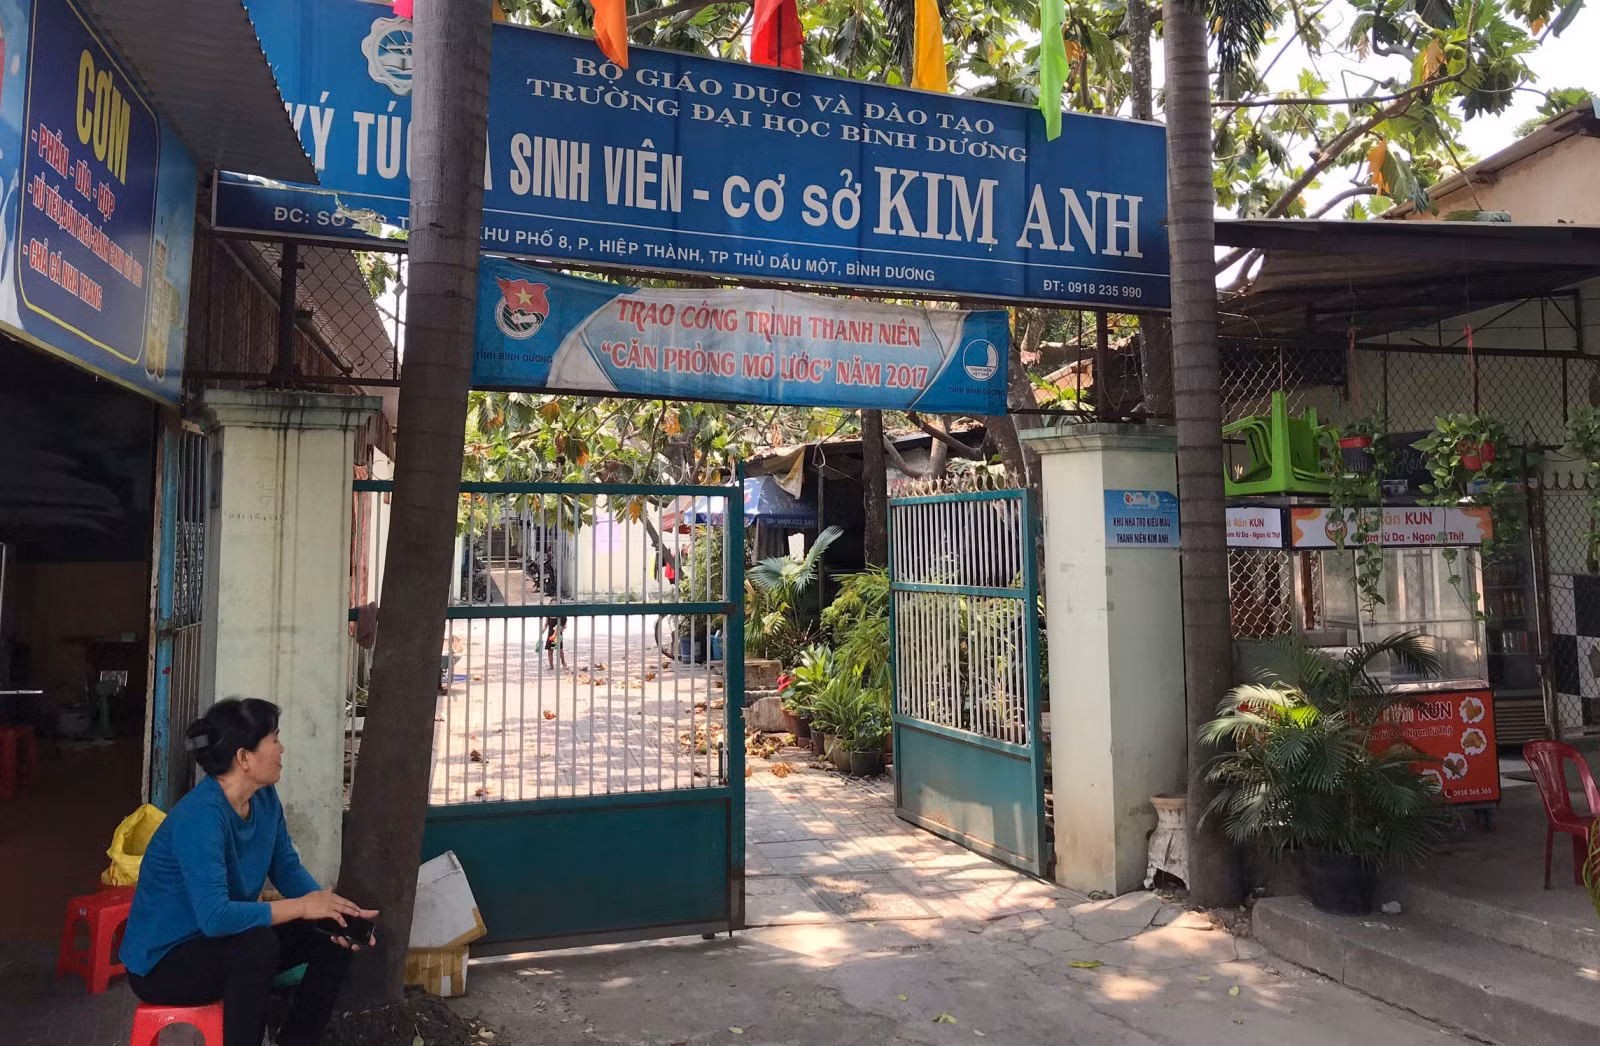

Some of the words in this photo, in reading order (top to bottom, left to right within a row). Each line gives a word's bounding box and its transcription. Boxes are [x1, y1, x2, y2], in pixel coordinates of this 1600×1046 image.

[573, 57, 624, 85] BỘ
[635, 69, 723, 96] GIÁO
[732, 82, 801, 108] DỤC
[811, 93, 854, 116] VÀ
[864, 101, 928, 125] ĐÀO
[936, 112, 995, 135] TẠO
[76, 49, 131, 186] CƠM
[526, 78, 682, 118] TRƯỜNG
[691, 103, 752, 128] ĐẠI
[762, 113, 831, 138] HỌC
[840, 122, 917, 149] BÌNH
[926, 136, 1028, 163] DƯƠNG
[352, 99, 412, 180] TÚ
[510, 132, 590, 202] SINH
[603, 138, 683, 213] VIÊN
[722, 173, 786, 222] CƠ
[801, 168, 863, 231] SỞ
[873, 165, 1000, 246] KIM
[1015, 183, 1144, 259] ANH
[274, 206, 310, 225] ĐC:
[515, 228, 553, 247] PHỐ
[558, 236, 572, 251] 8,
[578, 237, 593, 251] P.
[599, 237, 639, 254] HIỆP
[643, 242, 704, 264] THÀNH,
[709, 250, 729, 264] TP
[733, 250, 764, 268] THỦ
[770, 252, 801, 271] DẦU
[805, 257, 842, 276] MỘT,
[846, 260, 881, 278] BÌNH
[885, 266, 935, 282] DƯƠNG
[1043, 279, 1064, 293] ĐT:
[1067, 281, 1096, 295] 0918
[1098, 284, 1119, 297] 235
[1122, 286, 1142, 299] 990
[616, 298, 675, 333] TRAO
[680, 300, 738, 333] CÔNG
[745, 305, 802, 344] TRÌNH
[808, 315, 874, 344] THANH
[878, 318, 921, 348] NIÊN
[663, 342, 737, 379] PHÒNG
[742, 352, 777, 382] MƠ
[836, 356, 882, 387] NĂM
[886, 364, 929, 390] 2017
[1113, 517, 1124, 527] KHU
[1249, 518, 1265, 527] KUN
[1381, 511, 1401, 525] án
[1405, 511, 1433, 526] KUN
[1147, 533, 1157, 544] KIM
[1158, 533, 1169, 544] ANH
[1392, 532, 1405, 542] Da
[1412, 532, 1436, 544] Ngon
[1417, 700, 1453, 721] KUN
[1407, 727, 1428, 740] Ngon
